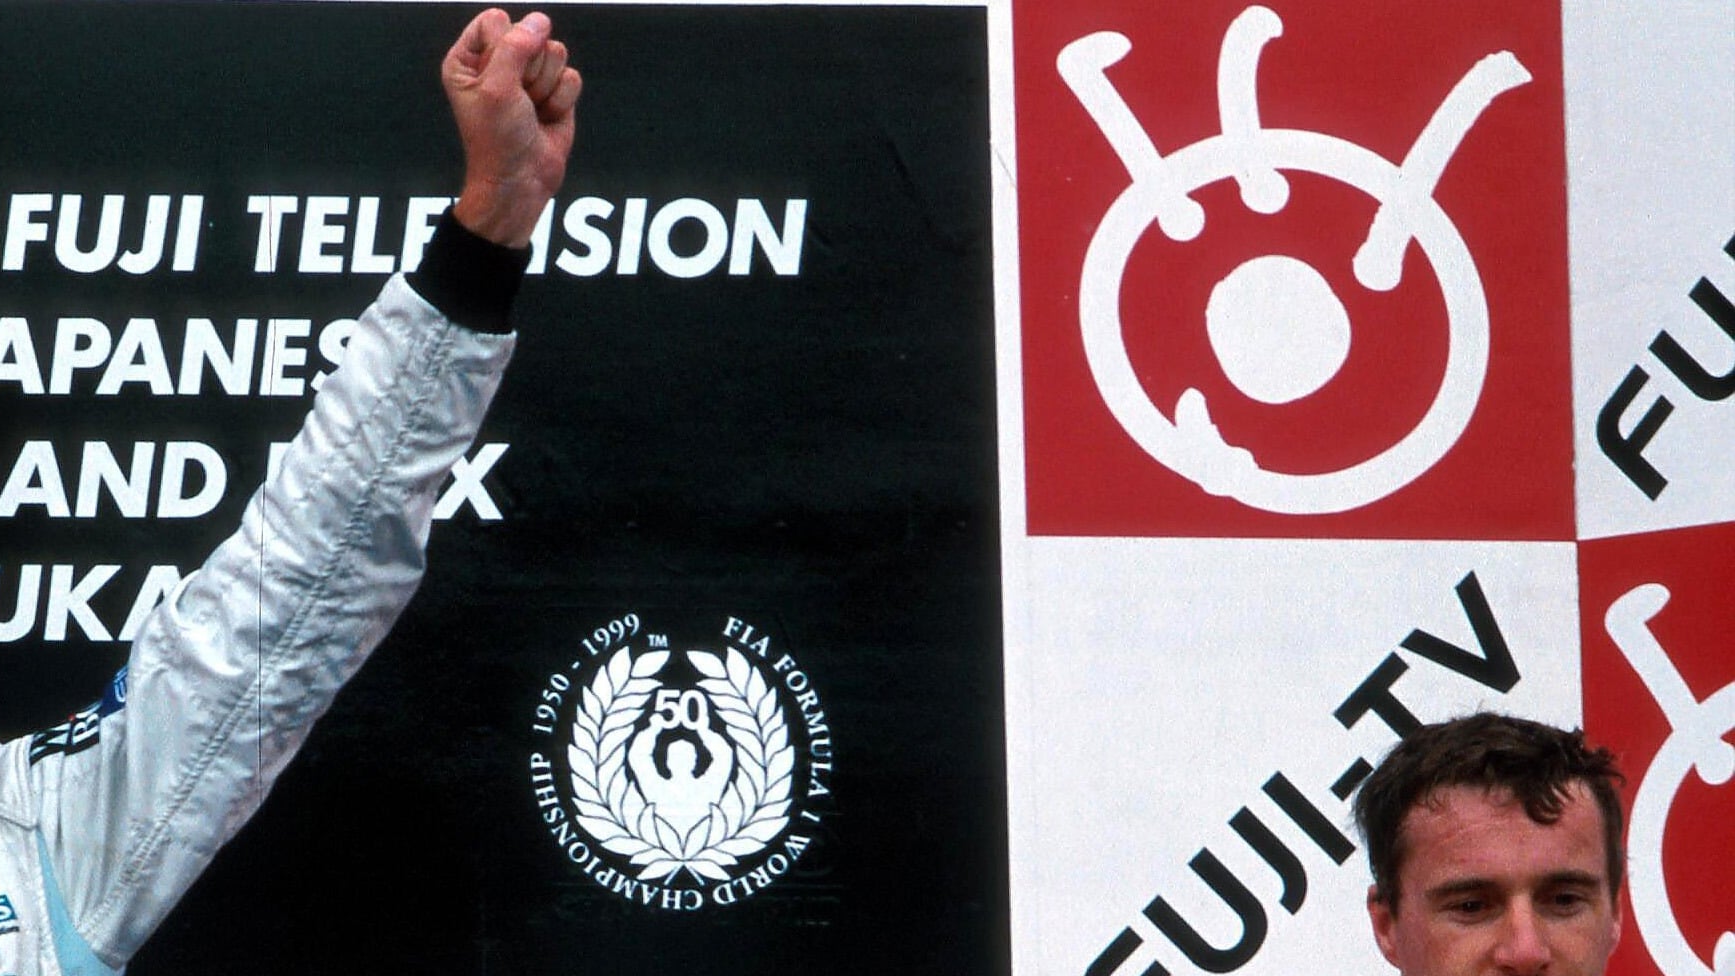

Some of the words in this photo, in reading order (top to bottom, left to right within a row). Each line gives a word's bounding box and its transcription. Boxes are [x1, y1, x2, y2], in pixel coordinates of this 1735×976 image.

[2, 194, 204, 273] FUJI
[533, 672, 570, 734] 1950
[582, 613, 641, 656] 1999
[648, 634, 668, 647] TM
[723, 616, 771, 657] FIA
[655, 689, 708, 731] 50
[772, 654, 833, 798] FORMULA
[530, 752, 704, 911] CHAMPIONSHIP
[712, 833, 812, 906] WORLD
